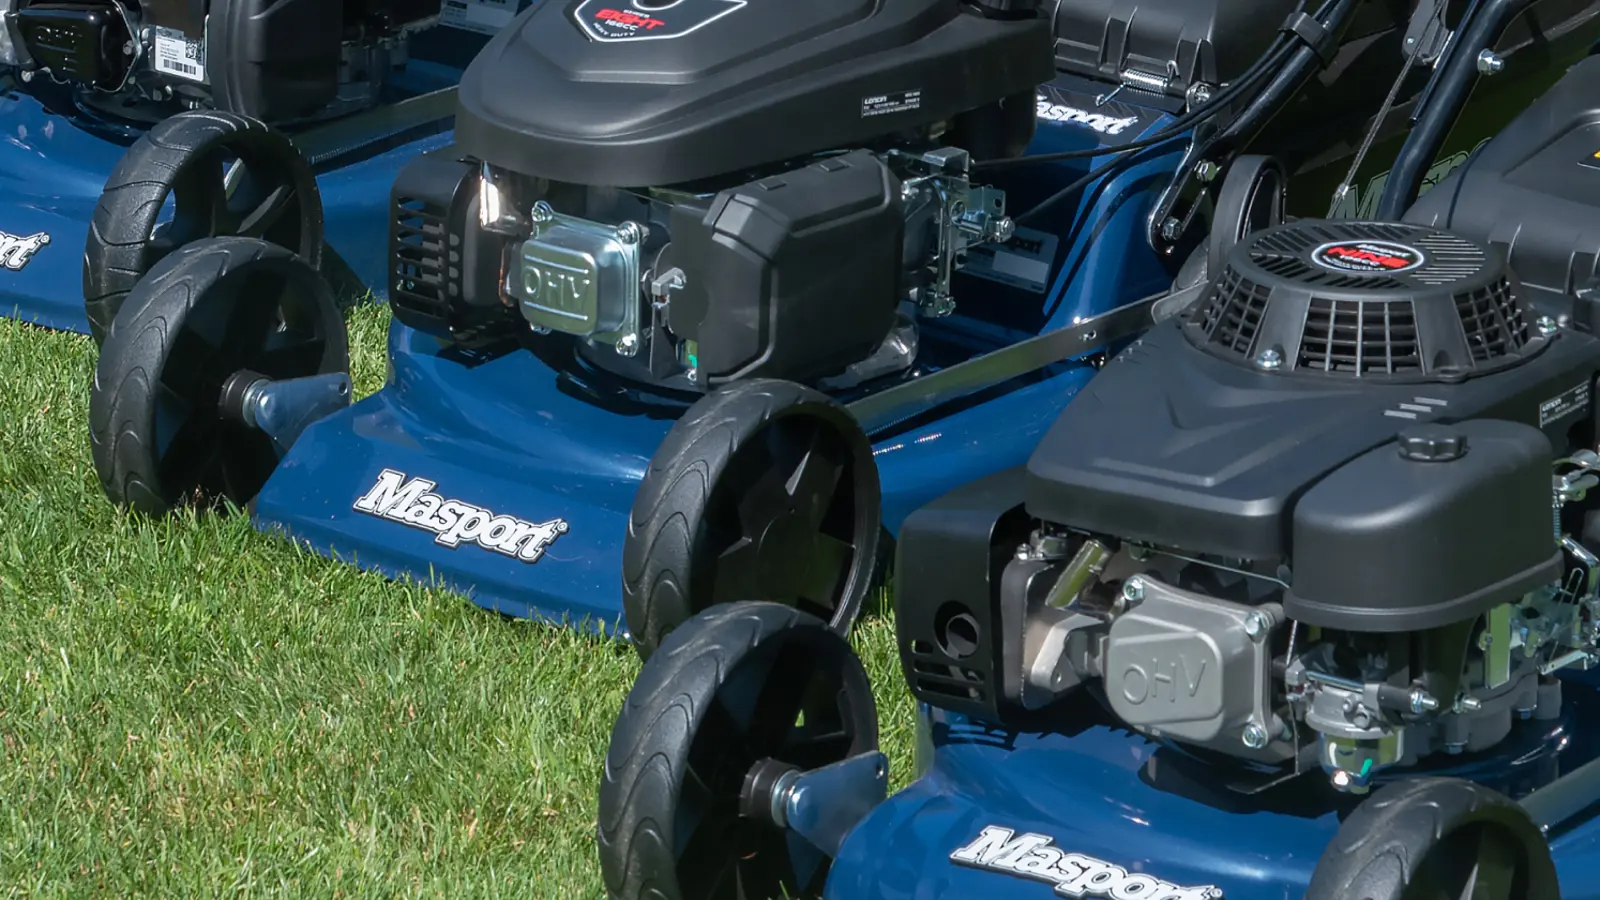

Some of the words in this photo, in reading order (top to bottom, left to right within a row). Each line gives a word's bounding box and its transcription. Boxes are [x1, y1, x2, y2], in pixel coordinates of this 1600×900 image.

[594, 8, 665, 30] EIGHT
[1036, 95, 1139, 135] asport
[525, 265, 591, 310] OHV
[352, 468, 569, 565] Masport
[1122, 653, 1207, 706] OHV
